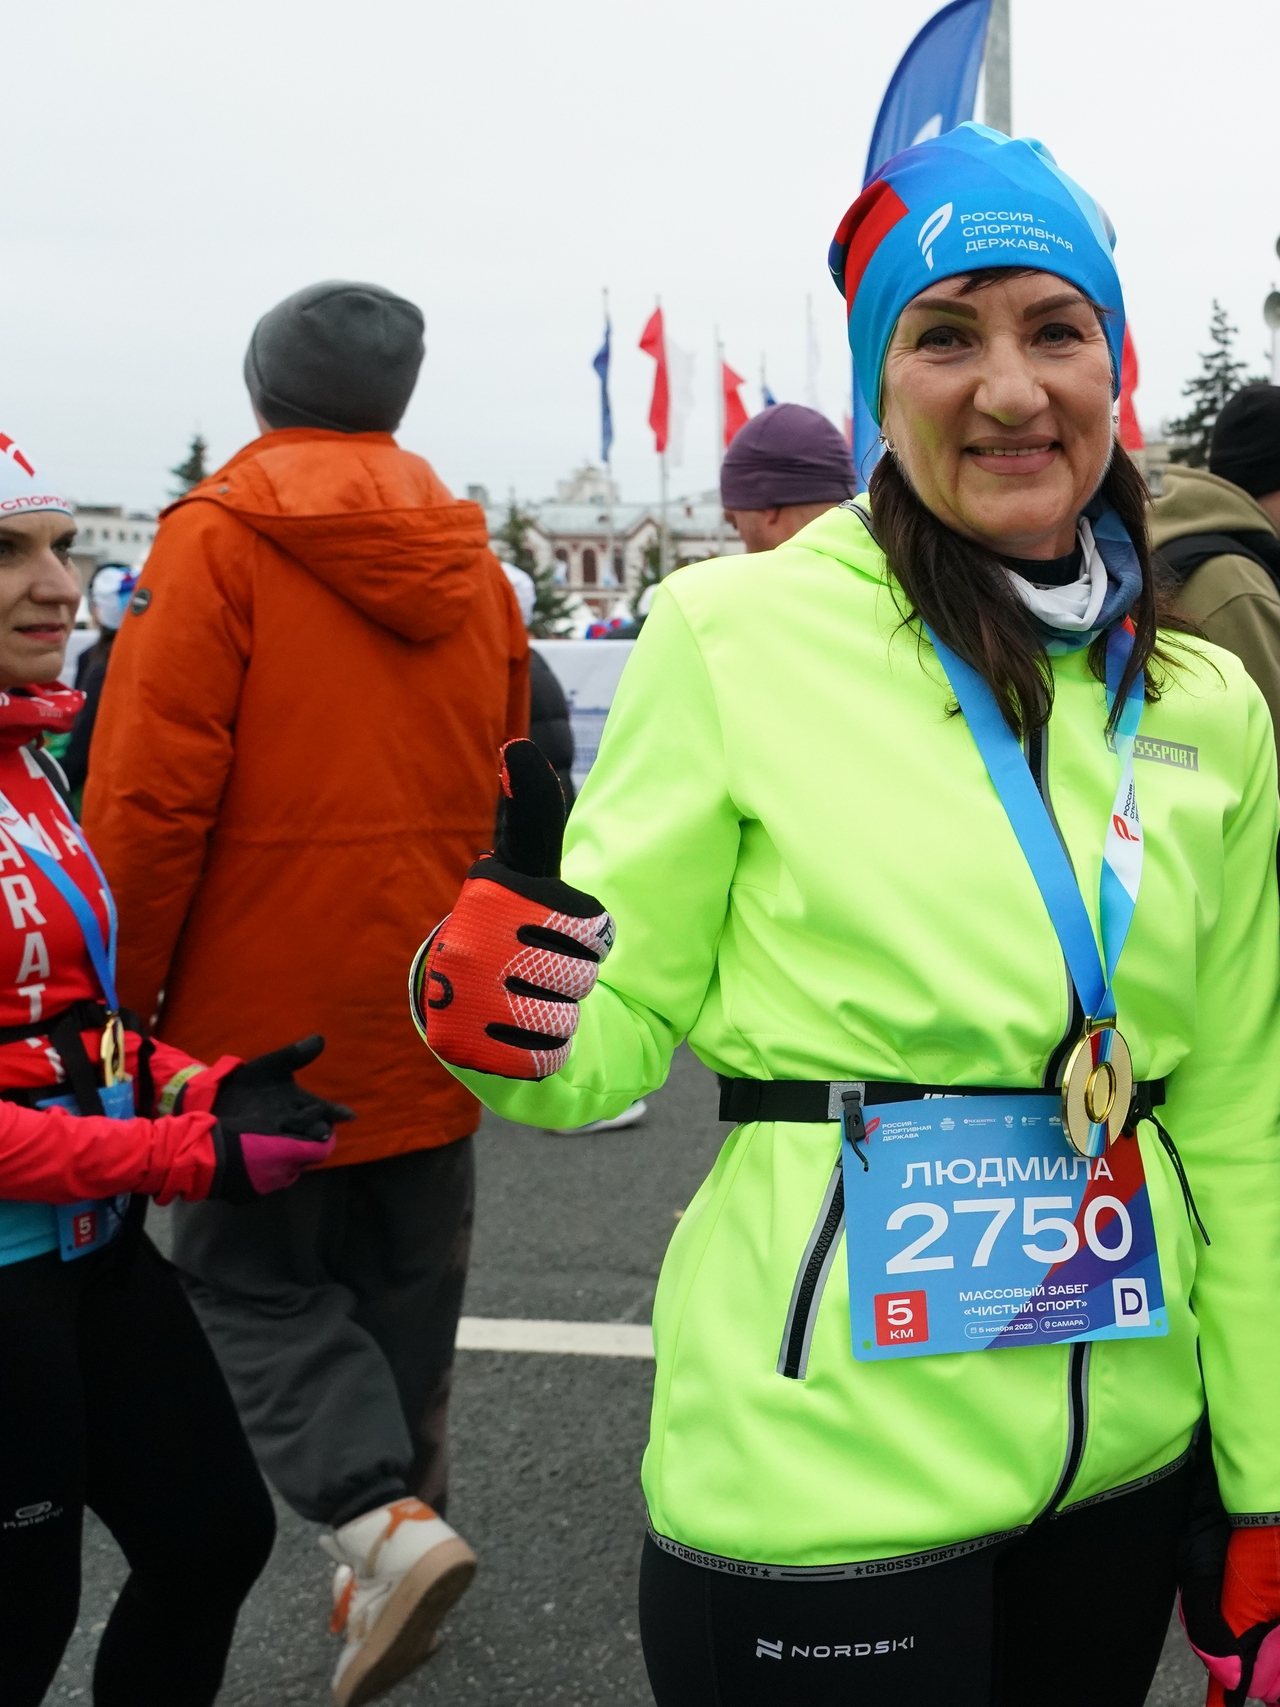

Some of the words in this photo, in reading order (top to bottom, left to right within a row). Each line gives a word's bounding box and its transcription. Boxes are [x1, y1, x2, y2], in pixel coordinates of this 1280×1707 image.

[960, 211, 1033, 224] РОССИЯ
[962, 224, 1073, 252] СПОРТИВНАЯ
[965, 238, 1050, 253] ДЕРЖАВА
[882, 1121, 912, 1129] РОССИЯ
[882, 1125, 932, 1135] СПОРТИВНАЯ
[883, 1133, 919, 1142] ДЕРЖАВА
[902, 1157, 1114, 1189] ЛЮДМИЛА
[79, 1216, 92, 1235] 5
[886, 1195, 1133, 1275] 2750
[959, 1285, 1046, 1302] МАССОВЫЙ
[1048, 1284, 1089, 1296] ЗАБЕГ
[1120, 1288, 1143, 1316] D
[887, 1299, 913, 1326] 5
[964, 1301, 1034, 1316] «ЧИСТЫЙ
[1036, 1300, 1088, 1312] СПОРТ»
[978, 1325, 985, 1333] 5
[985, 1324, 1014, 1334] ноября
[1014, 1323, 1034, 1331] 2025
[1051, 1319, 1085, 1329] САМАРА
[890, 1328, 914, 1340] КМ
[678, 1548, 758, 1575] CROSSSPORT
[865, 1549, 957, 1574] CROSSSPORT
[791, 1636, 914, 1658] NORDSKI
